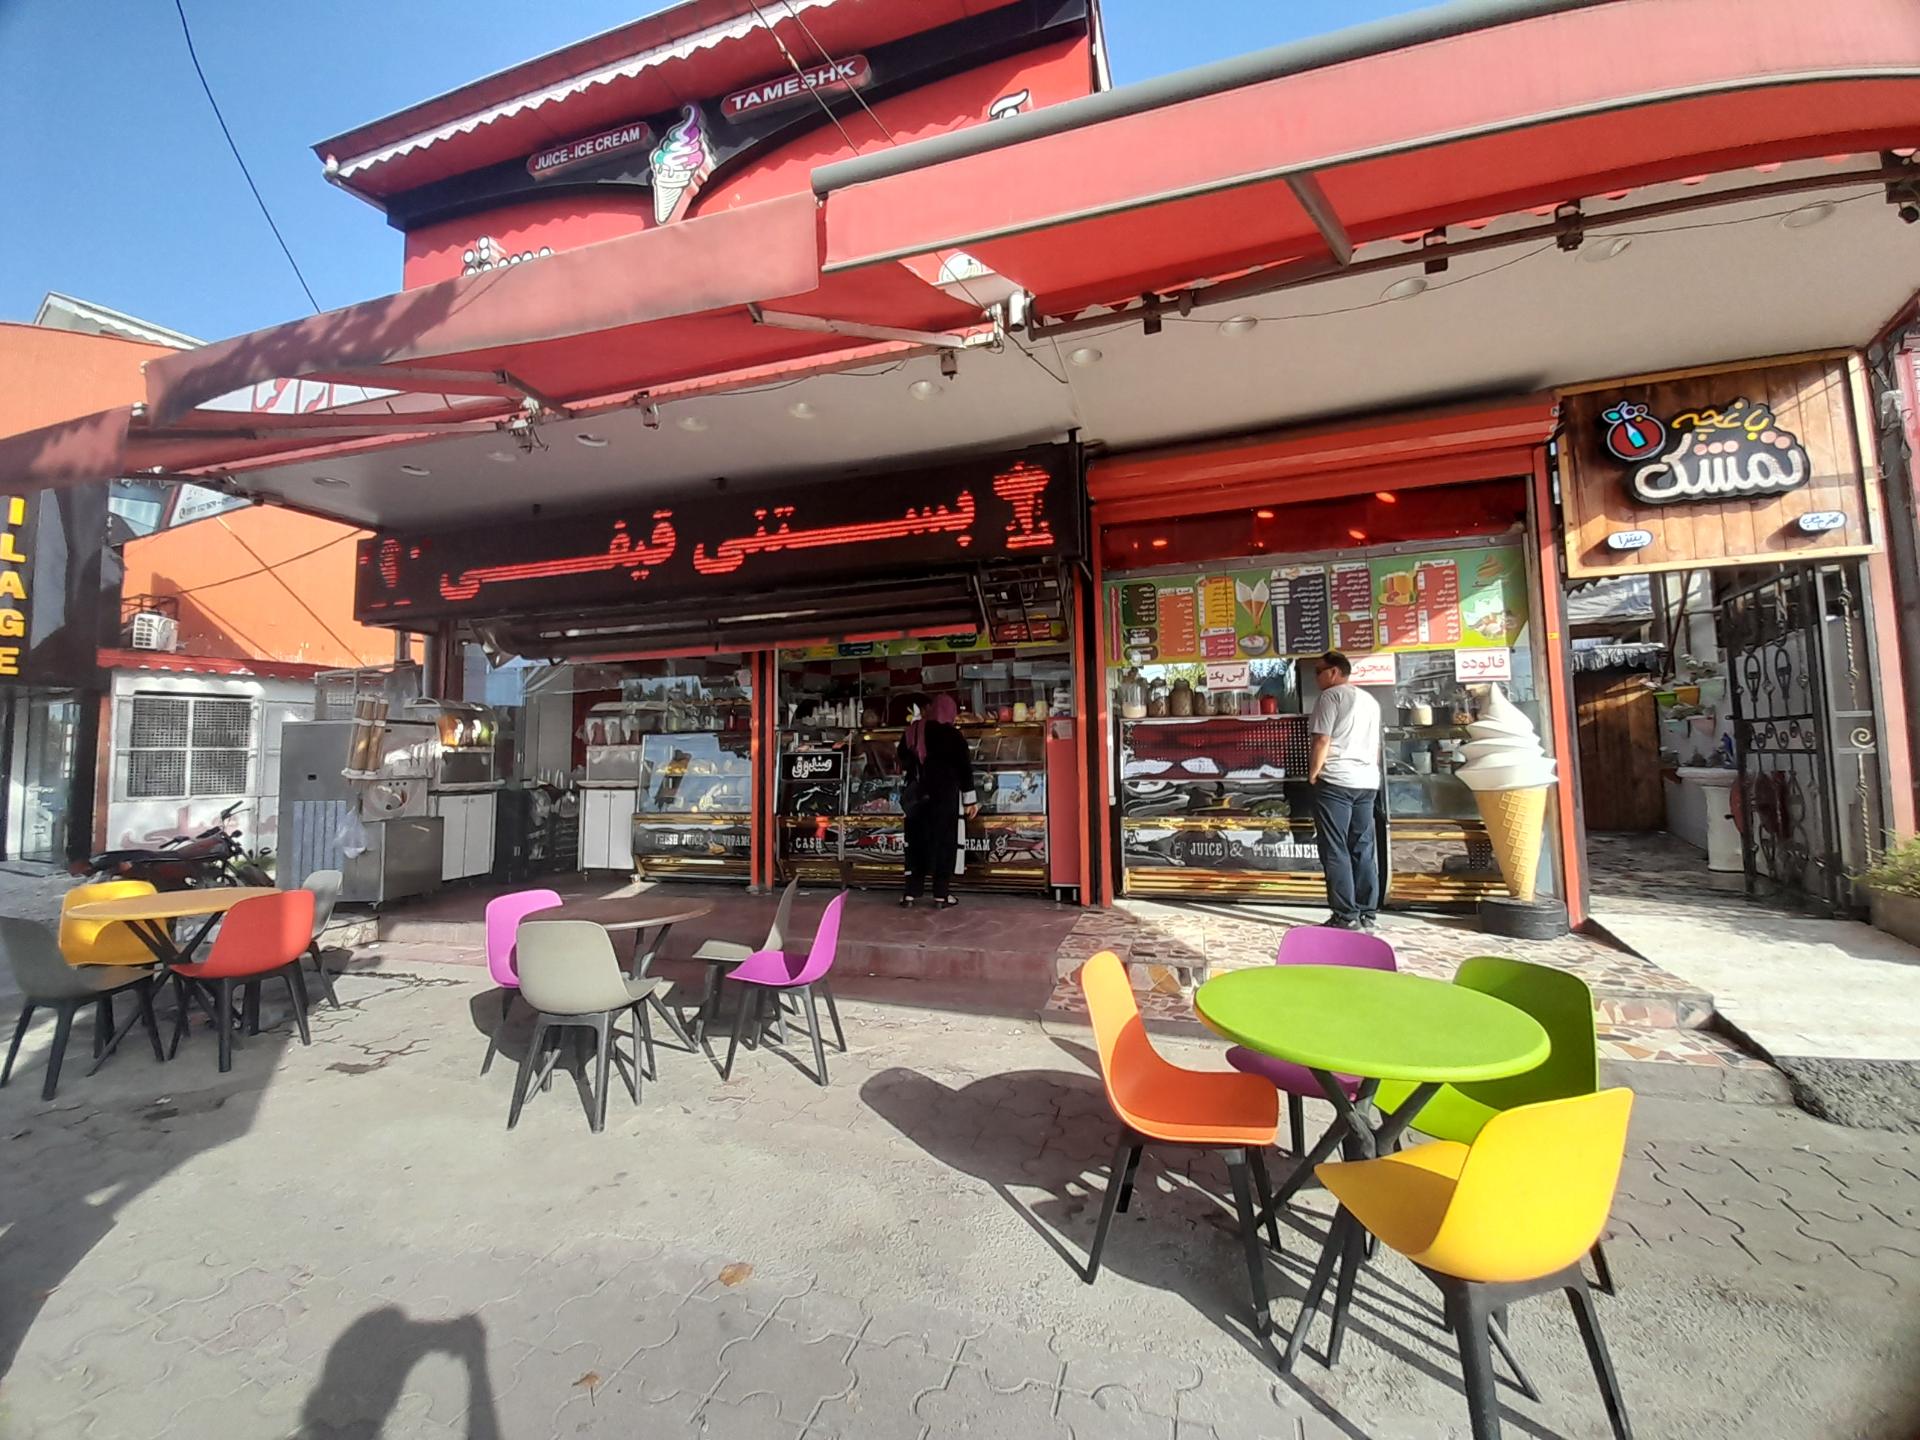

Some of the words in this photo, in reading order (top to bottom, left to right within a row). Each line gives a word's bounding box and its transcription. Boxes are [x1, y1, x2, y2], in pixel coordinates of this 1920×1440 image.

[731, 60, 857, 112] TAMESHK
[594, 127, 640, 152] CREAM
[1672, 402, 1770, 442] باغچه
[1635, 431, 1804, 499] تمشک
[693, 490, 976, 575] بستنی
[440, 509, 677, 600] قیفی
[1226, 667, 1246, 682] آیس
[1461, 654, 1505, 675] فالوده
[792, 756, 832, 779] صندوق
[795, 838, 822, 850] CASH
[964, 838, 990, 851] REAM
[1190, 842, 1223, 856] JUICE
[1229, 843, 1244, 857] &
